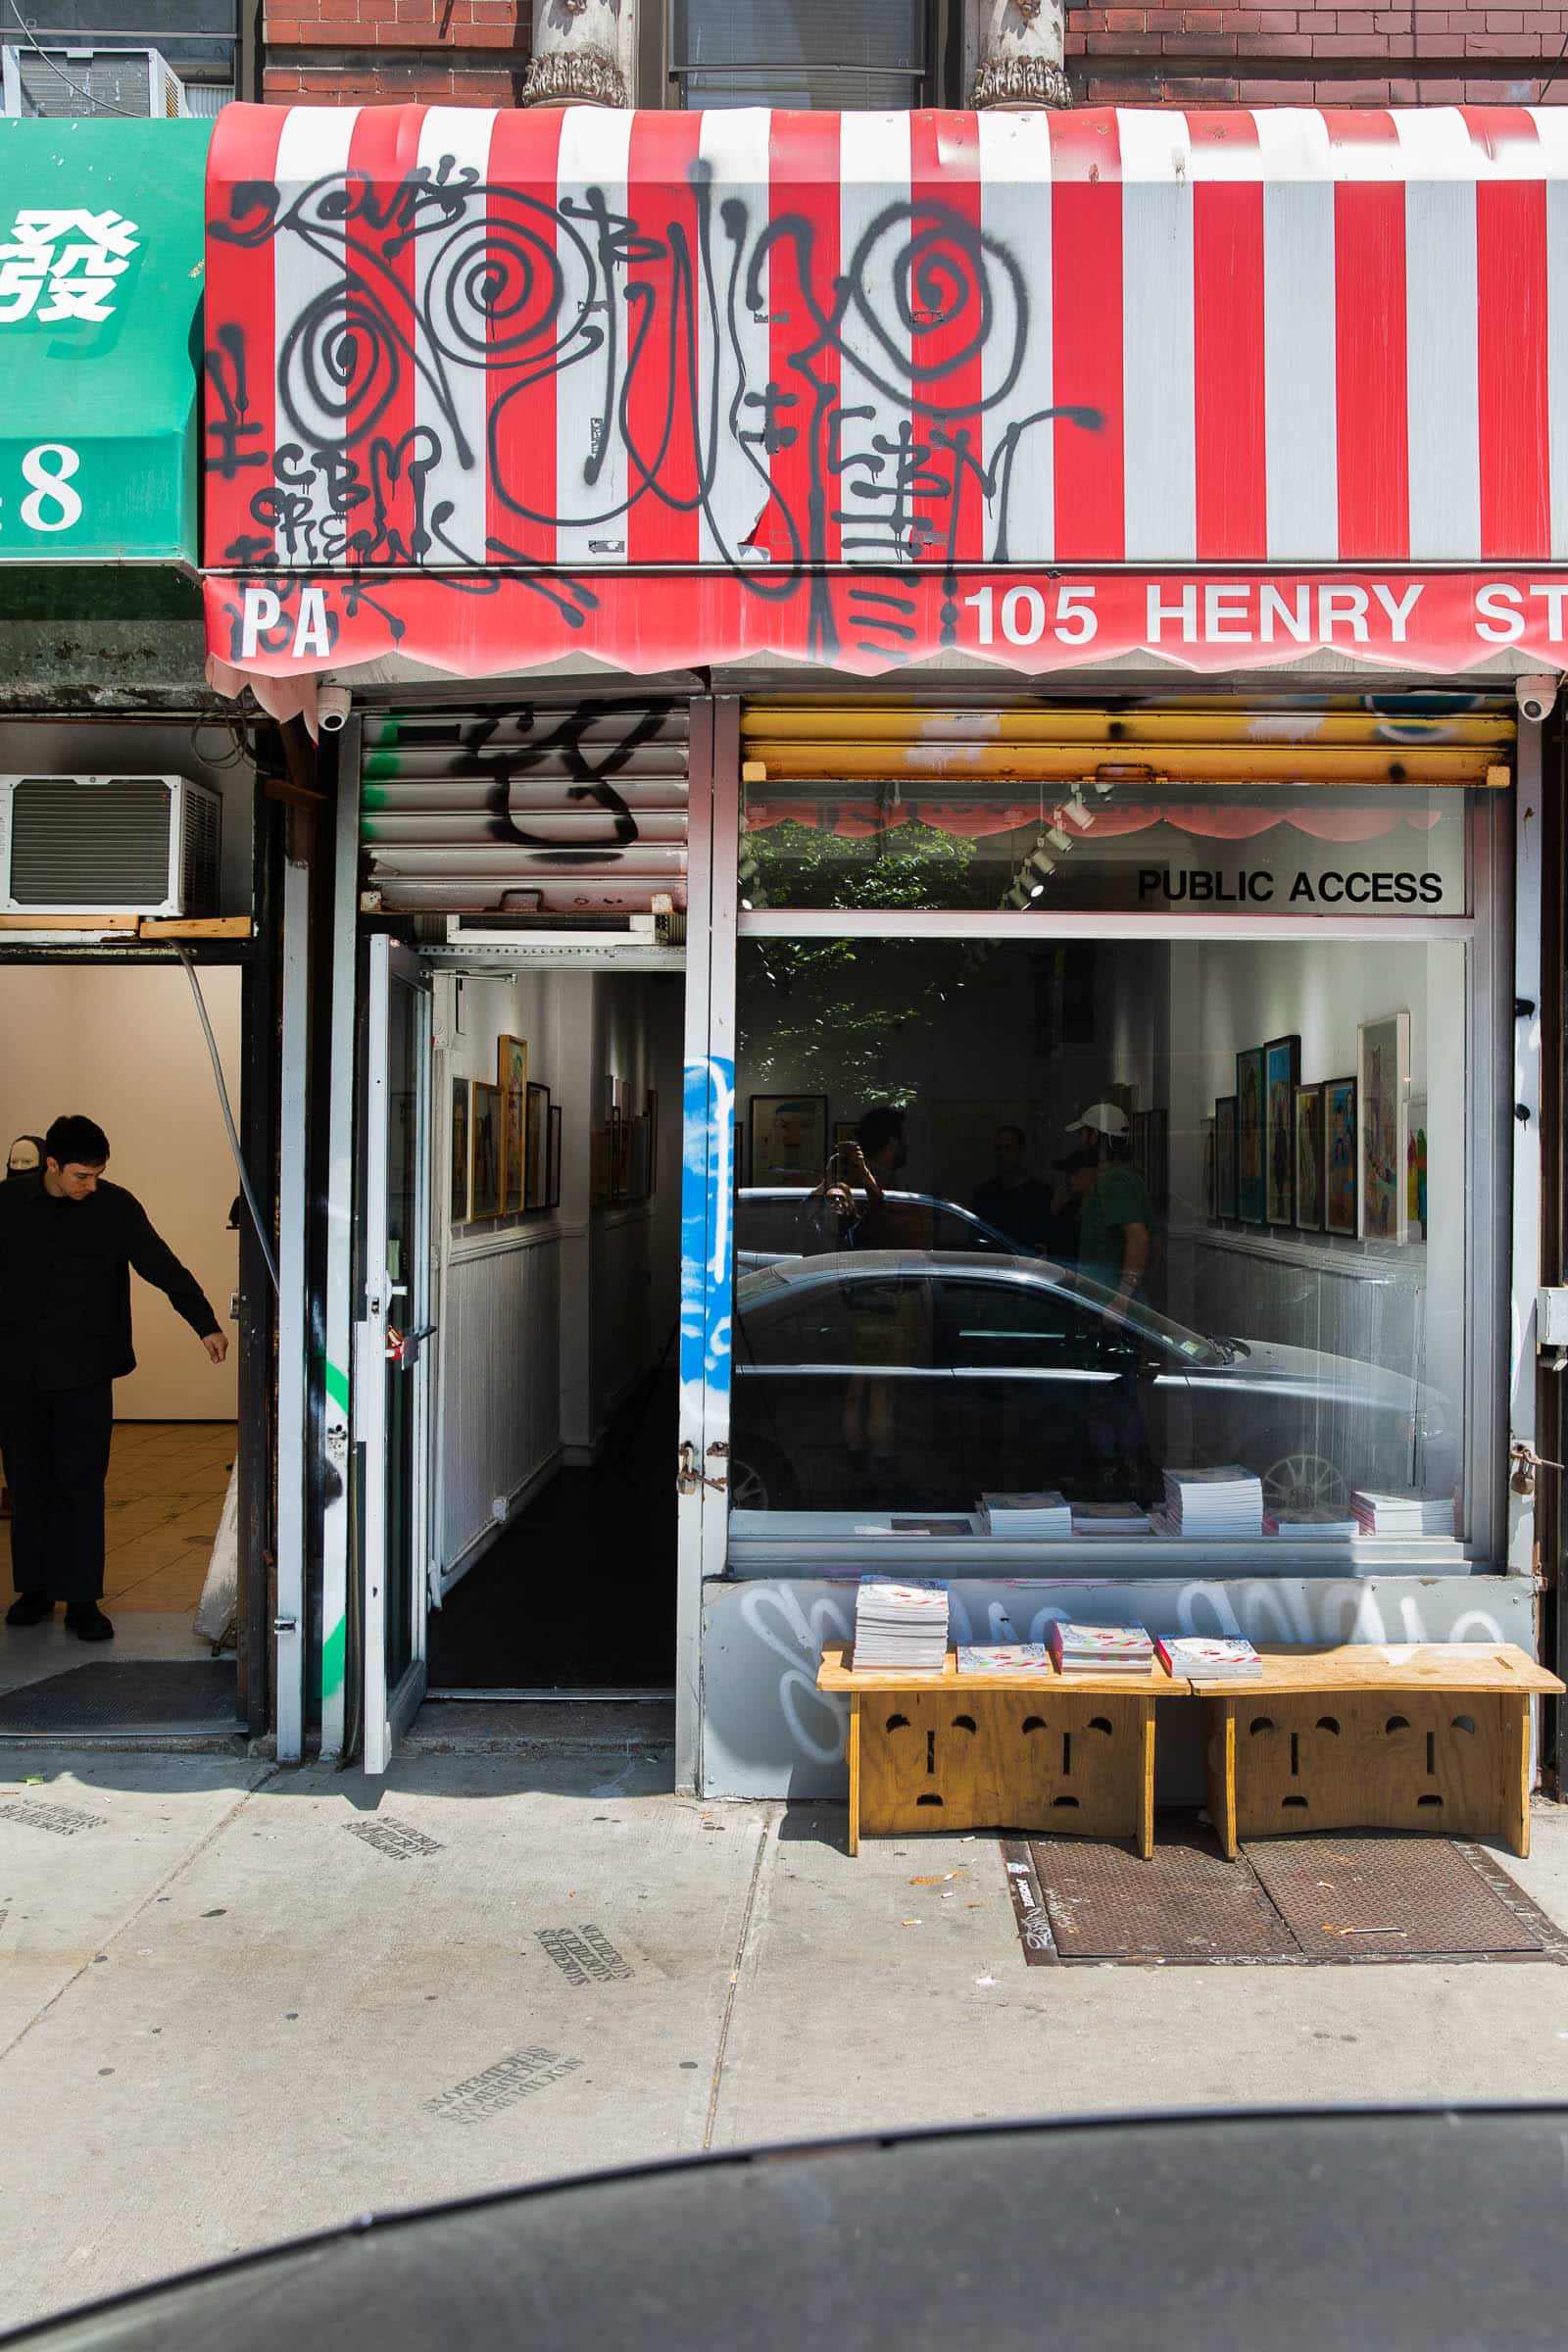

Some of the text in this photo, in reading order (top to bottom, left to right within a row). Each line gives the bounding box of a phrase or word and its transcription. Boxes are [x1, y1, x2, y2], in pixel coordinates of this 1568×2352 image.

[0, 209, 141, 322] 發
[964, 583, 1568, 645] 105 HENRY ST
[1138, 870, 1444, 903] PUBLIC ACCESS
